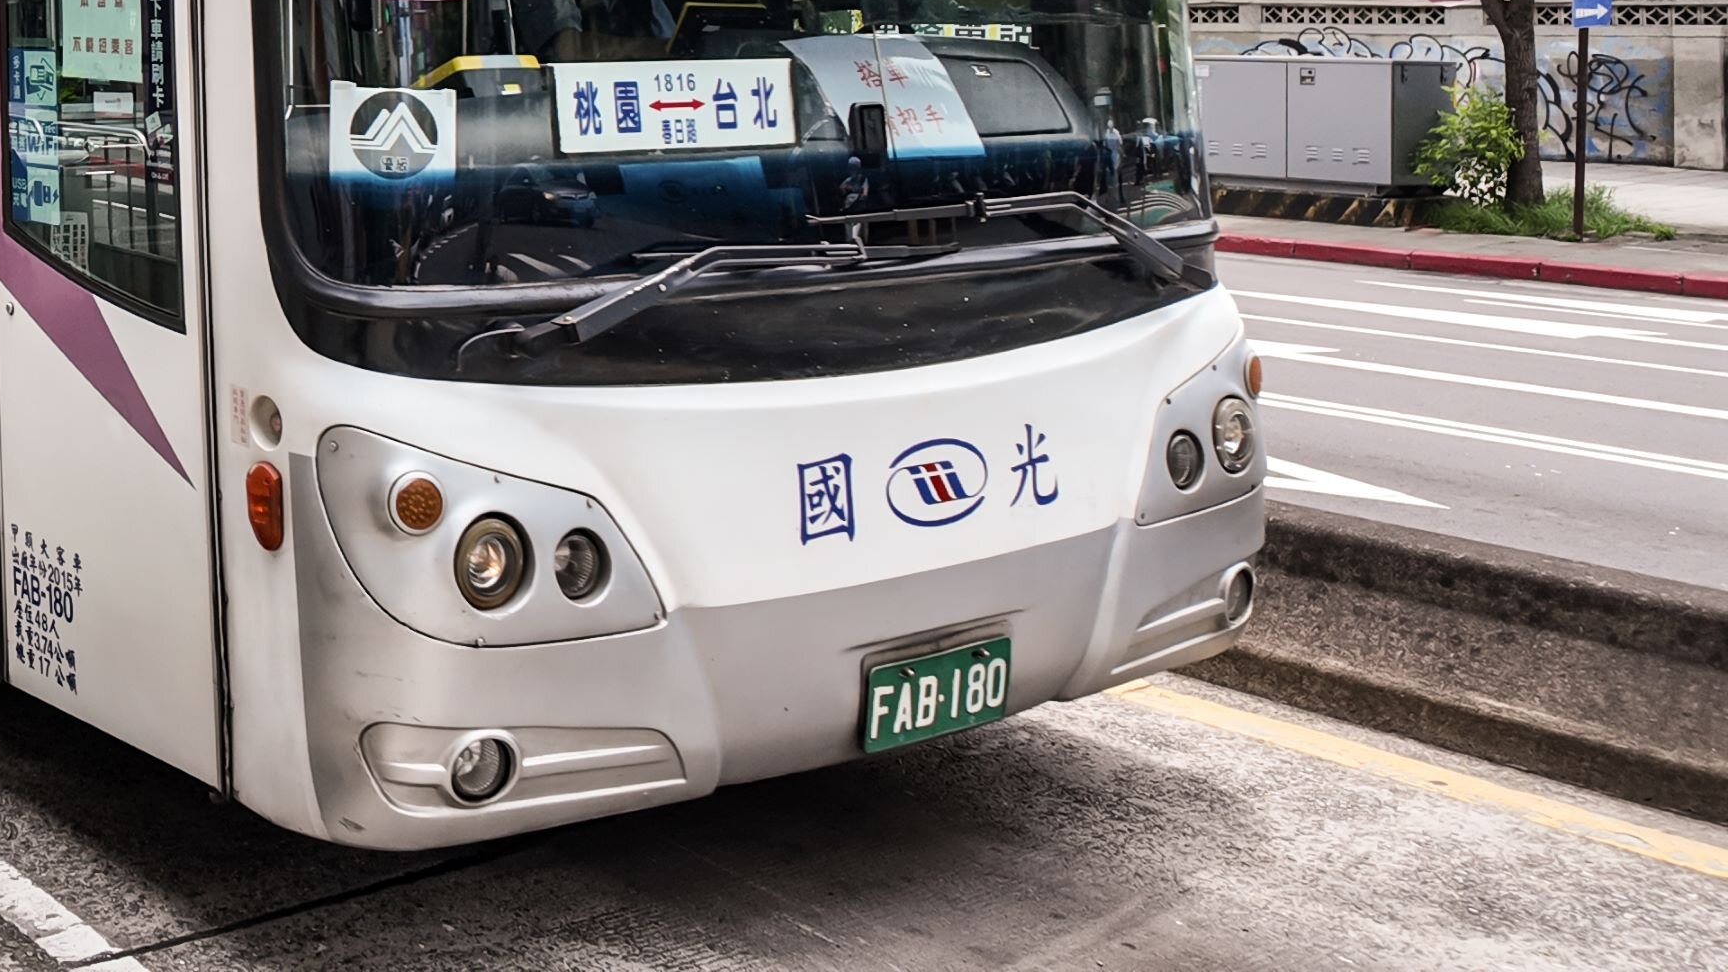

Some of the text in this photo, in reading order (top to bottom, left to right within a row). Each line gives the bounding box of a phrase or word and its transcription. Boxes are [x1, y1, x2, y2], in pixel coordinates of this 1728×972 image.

[573, 77, 777, 136] 桃園 台北
[654, 73, 696, 92] 1816
[797, 424, 1059, 545] 國 光
[13, 566, 73, 623] FAB-180
